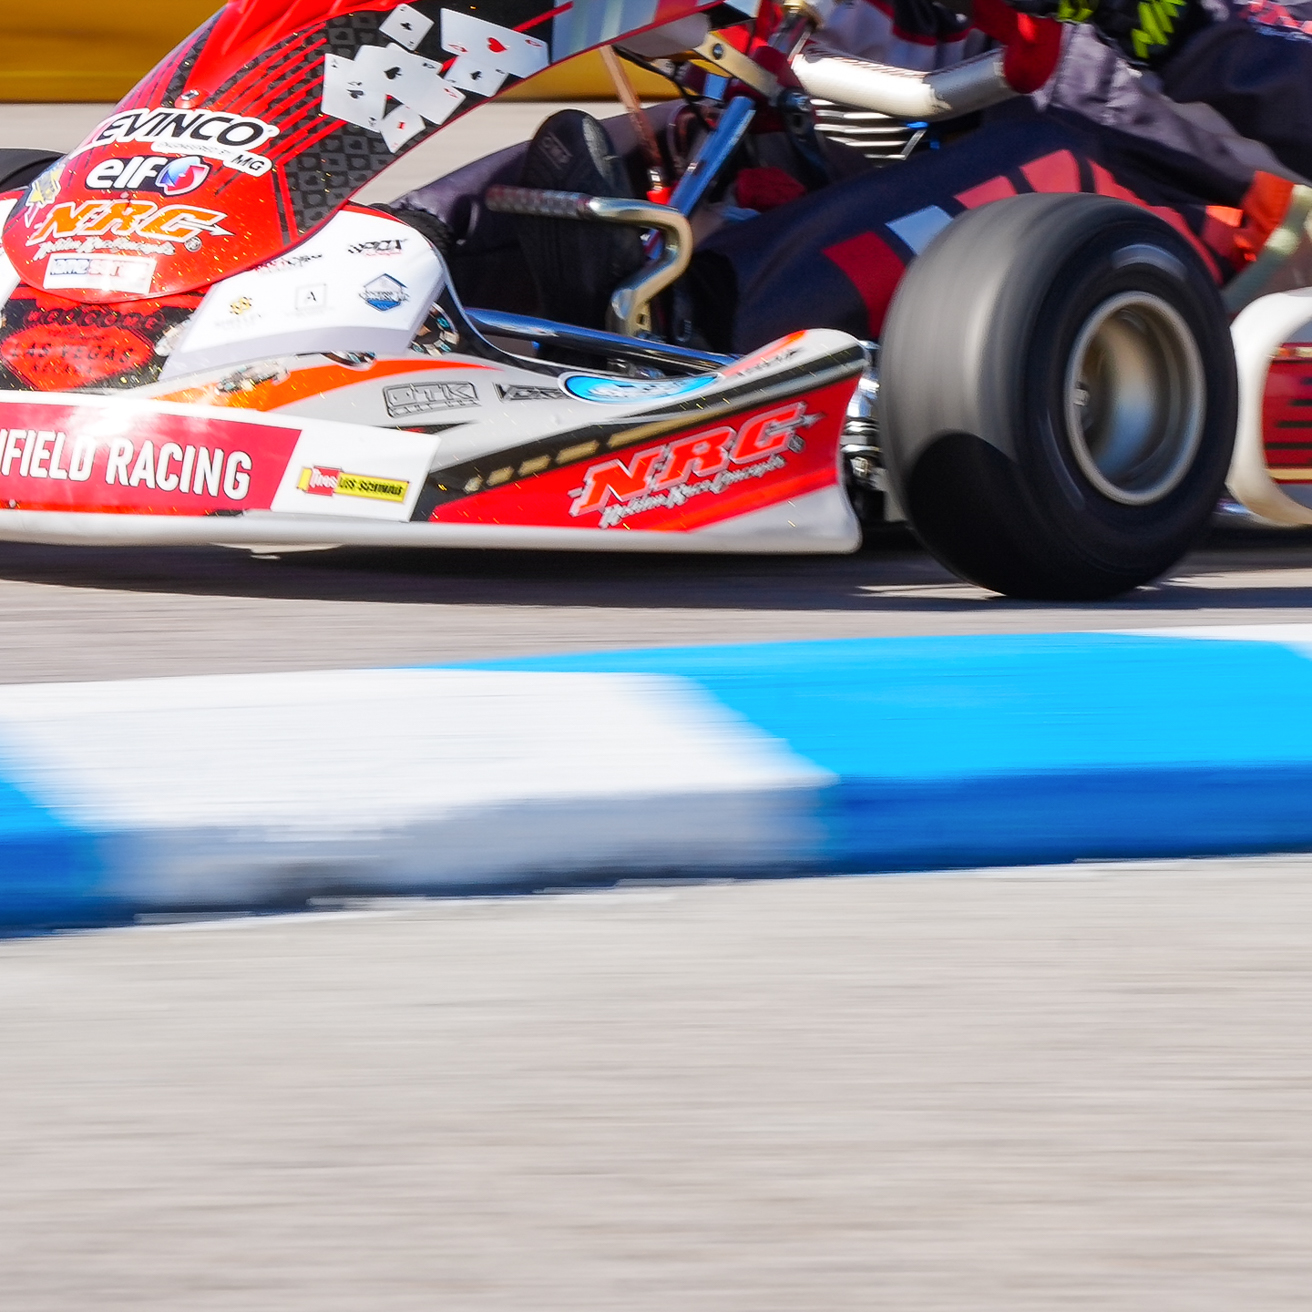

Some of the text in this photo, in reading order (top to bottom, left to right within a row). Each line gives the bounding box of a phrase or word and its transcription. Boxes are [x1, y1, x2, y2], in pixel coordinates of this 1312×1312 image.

[94, 112, 265, 147] EVINCO
[87, 157, 169, 189] elf
[230, 154, 265, 172] MG
[30, 201, 228, 244] NRC
[11, 342, 134, 364] LAS VEGAS
[388, 382, 478, 406] OTK
[105, 437, 252, 501] RACING
[572, 404, 804, 515] NRC
